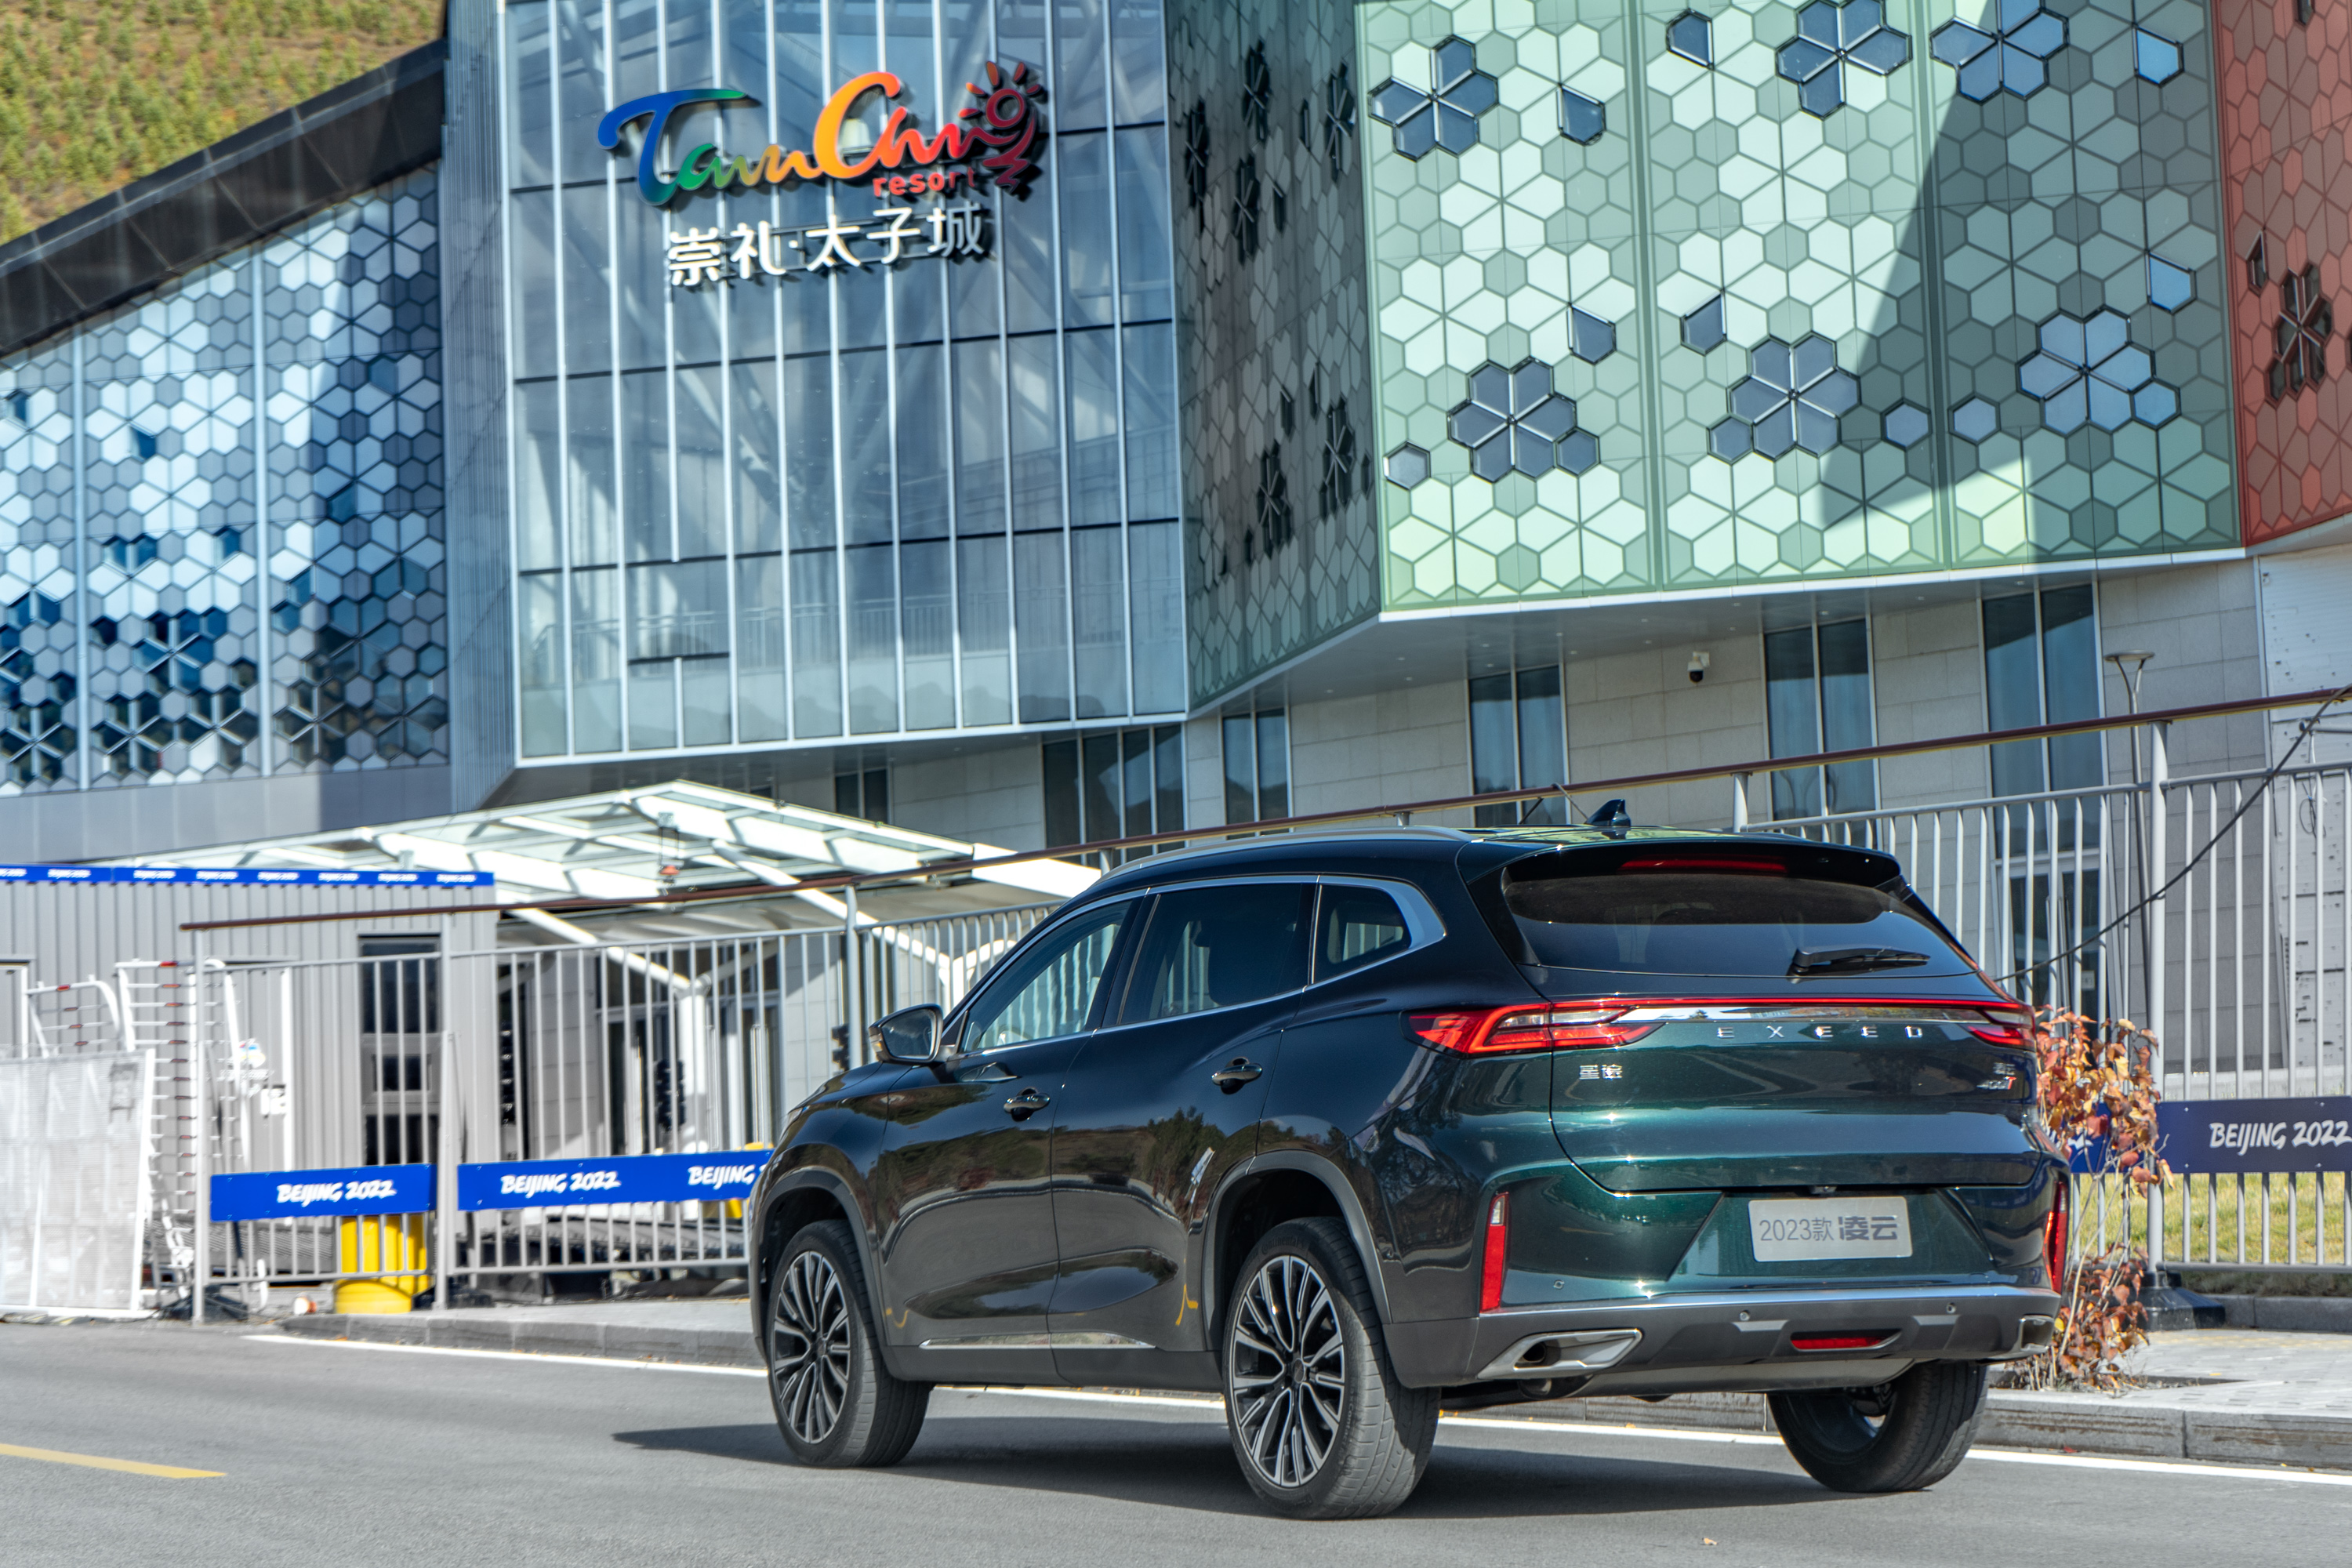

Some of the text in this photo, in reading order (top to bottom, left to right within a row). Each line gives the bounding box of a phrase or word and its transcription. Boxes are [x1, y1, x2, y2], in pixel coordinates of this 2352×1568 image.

[873, 166, 976, 197] resort
[1717, 1025, 1922, 1039] EXEED
[2209, 1120, 2352, 1156] BEIJING 2022
[500, 1171, 622, 1199] BEIJING 2022
[688, 1164, 756, 1190] BEIJING
[277, 1179, 397, 1207] BEIJING 2022
